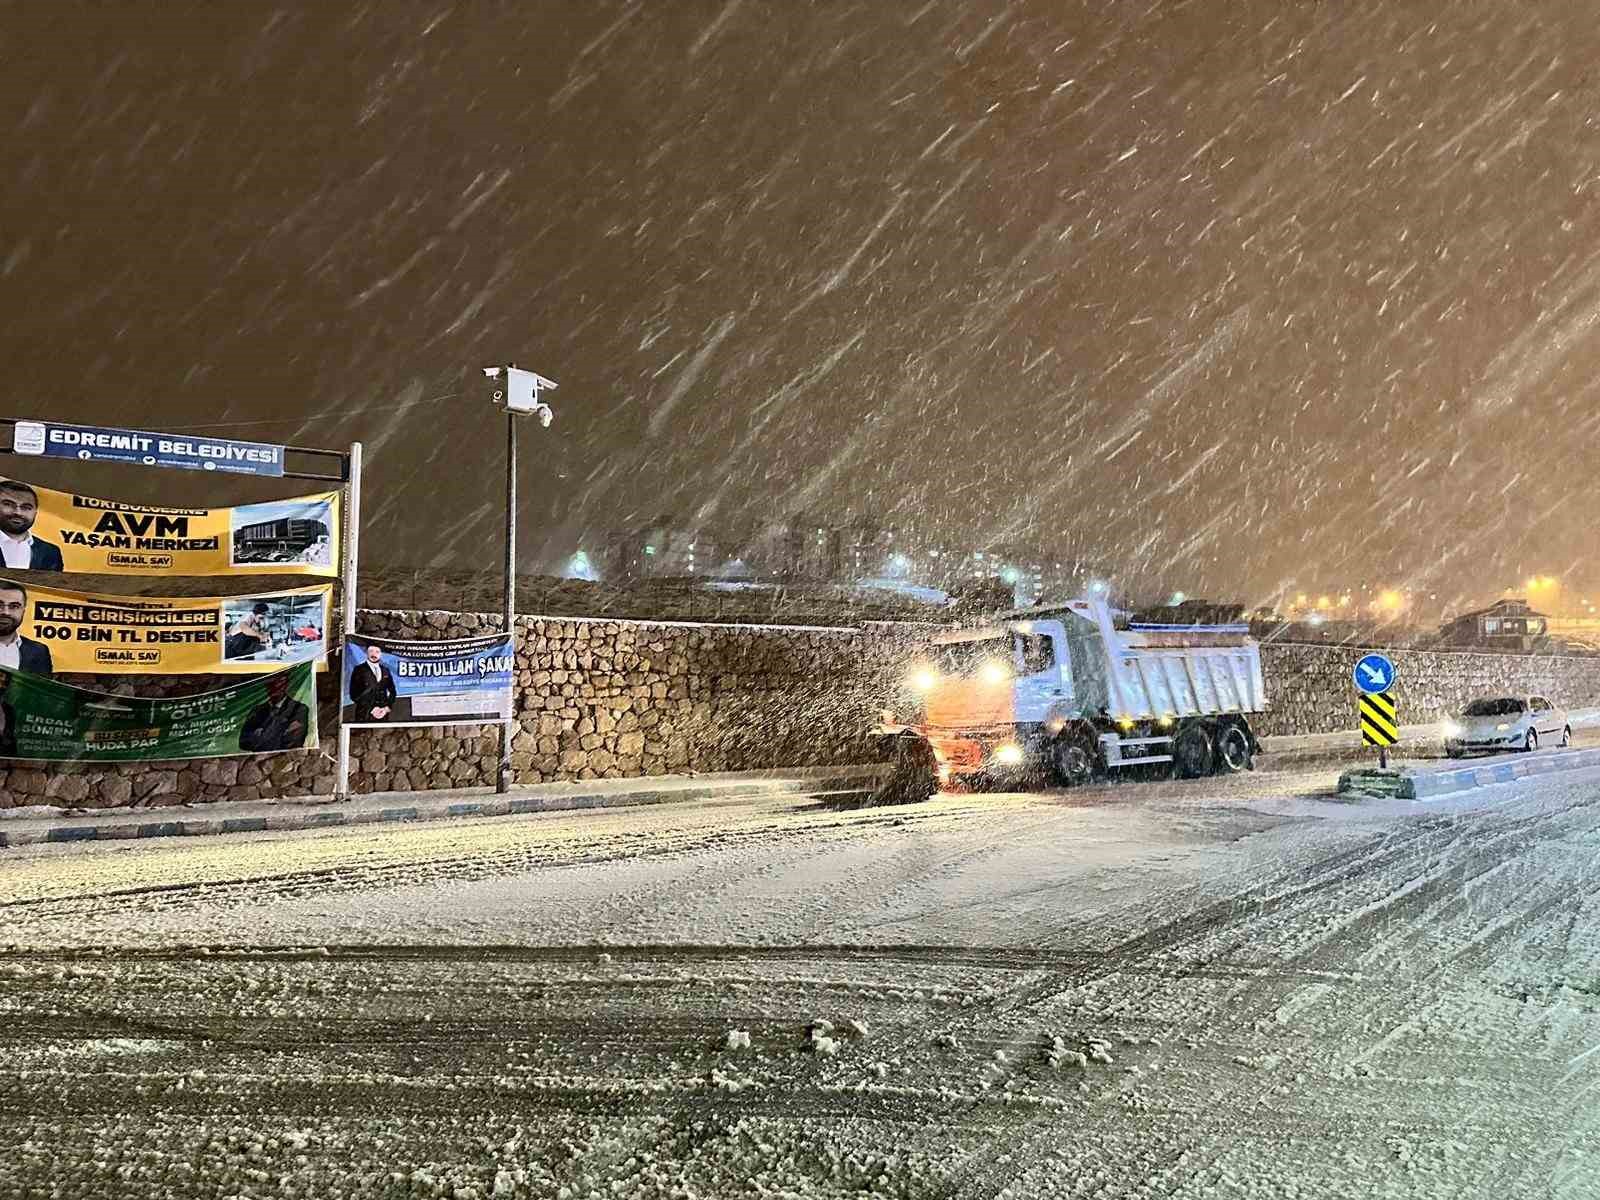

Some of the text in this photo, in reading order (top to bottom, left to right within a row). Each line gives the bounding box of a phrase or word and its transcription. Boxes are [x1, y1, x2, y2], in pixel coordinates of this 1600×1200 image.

[49, 430, 278, 464] EDREMİT BELEDİYESİ
[93, 511, 188, 537] AVM
[60, 530, 219, 551] YAŞAM MERKEZİ
[150, 556, 171, 565] SAY
[40, 606, 216, 624] YENİ GİRİŞİMCİLERE
[33, 624, 219, 643] 100 BİN TL DESTEK
[97, 649, 159, 660] İSMAİL SAY
[398, 659, 474, 677] BEYTULLAH
[130, 737, 159, 749] PAR
